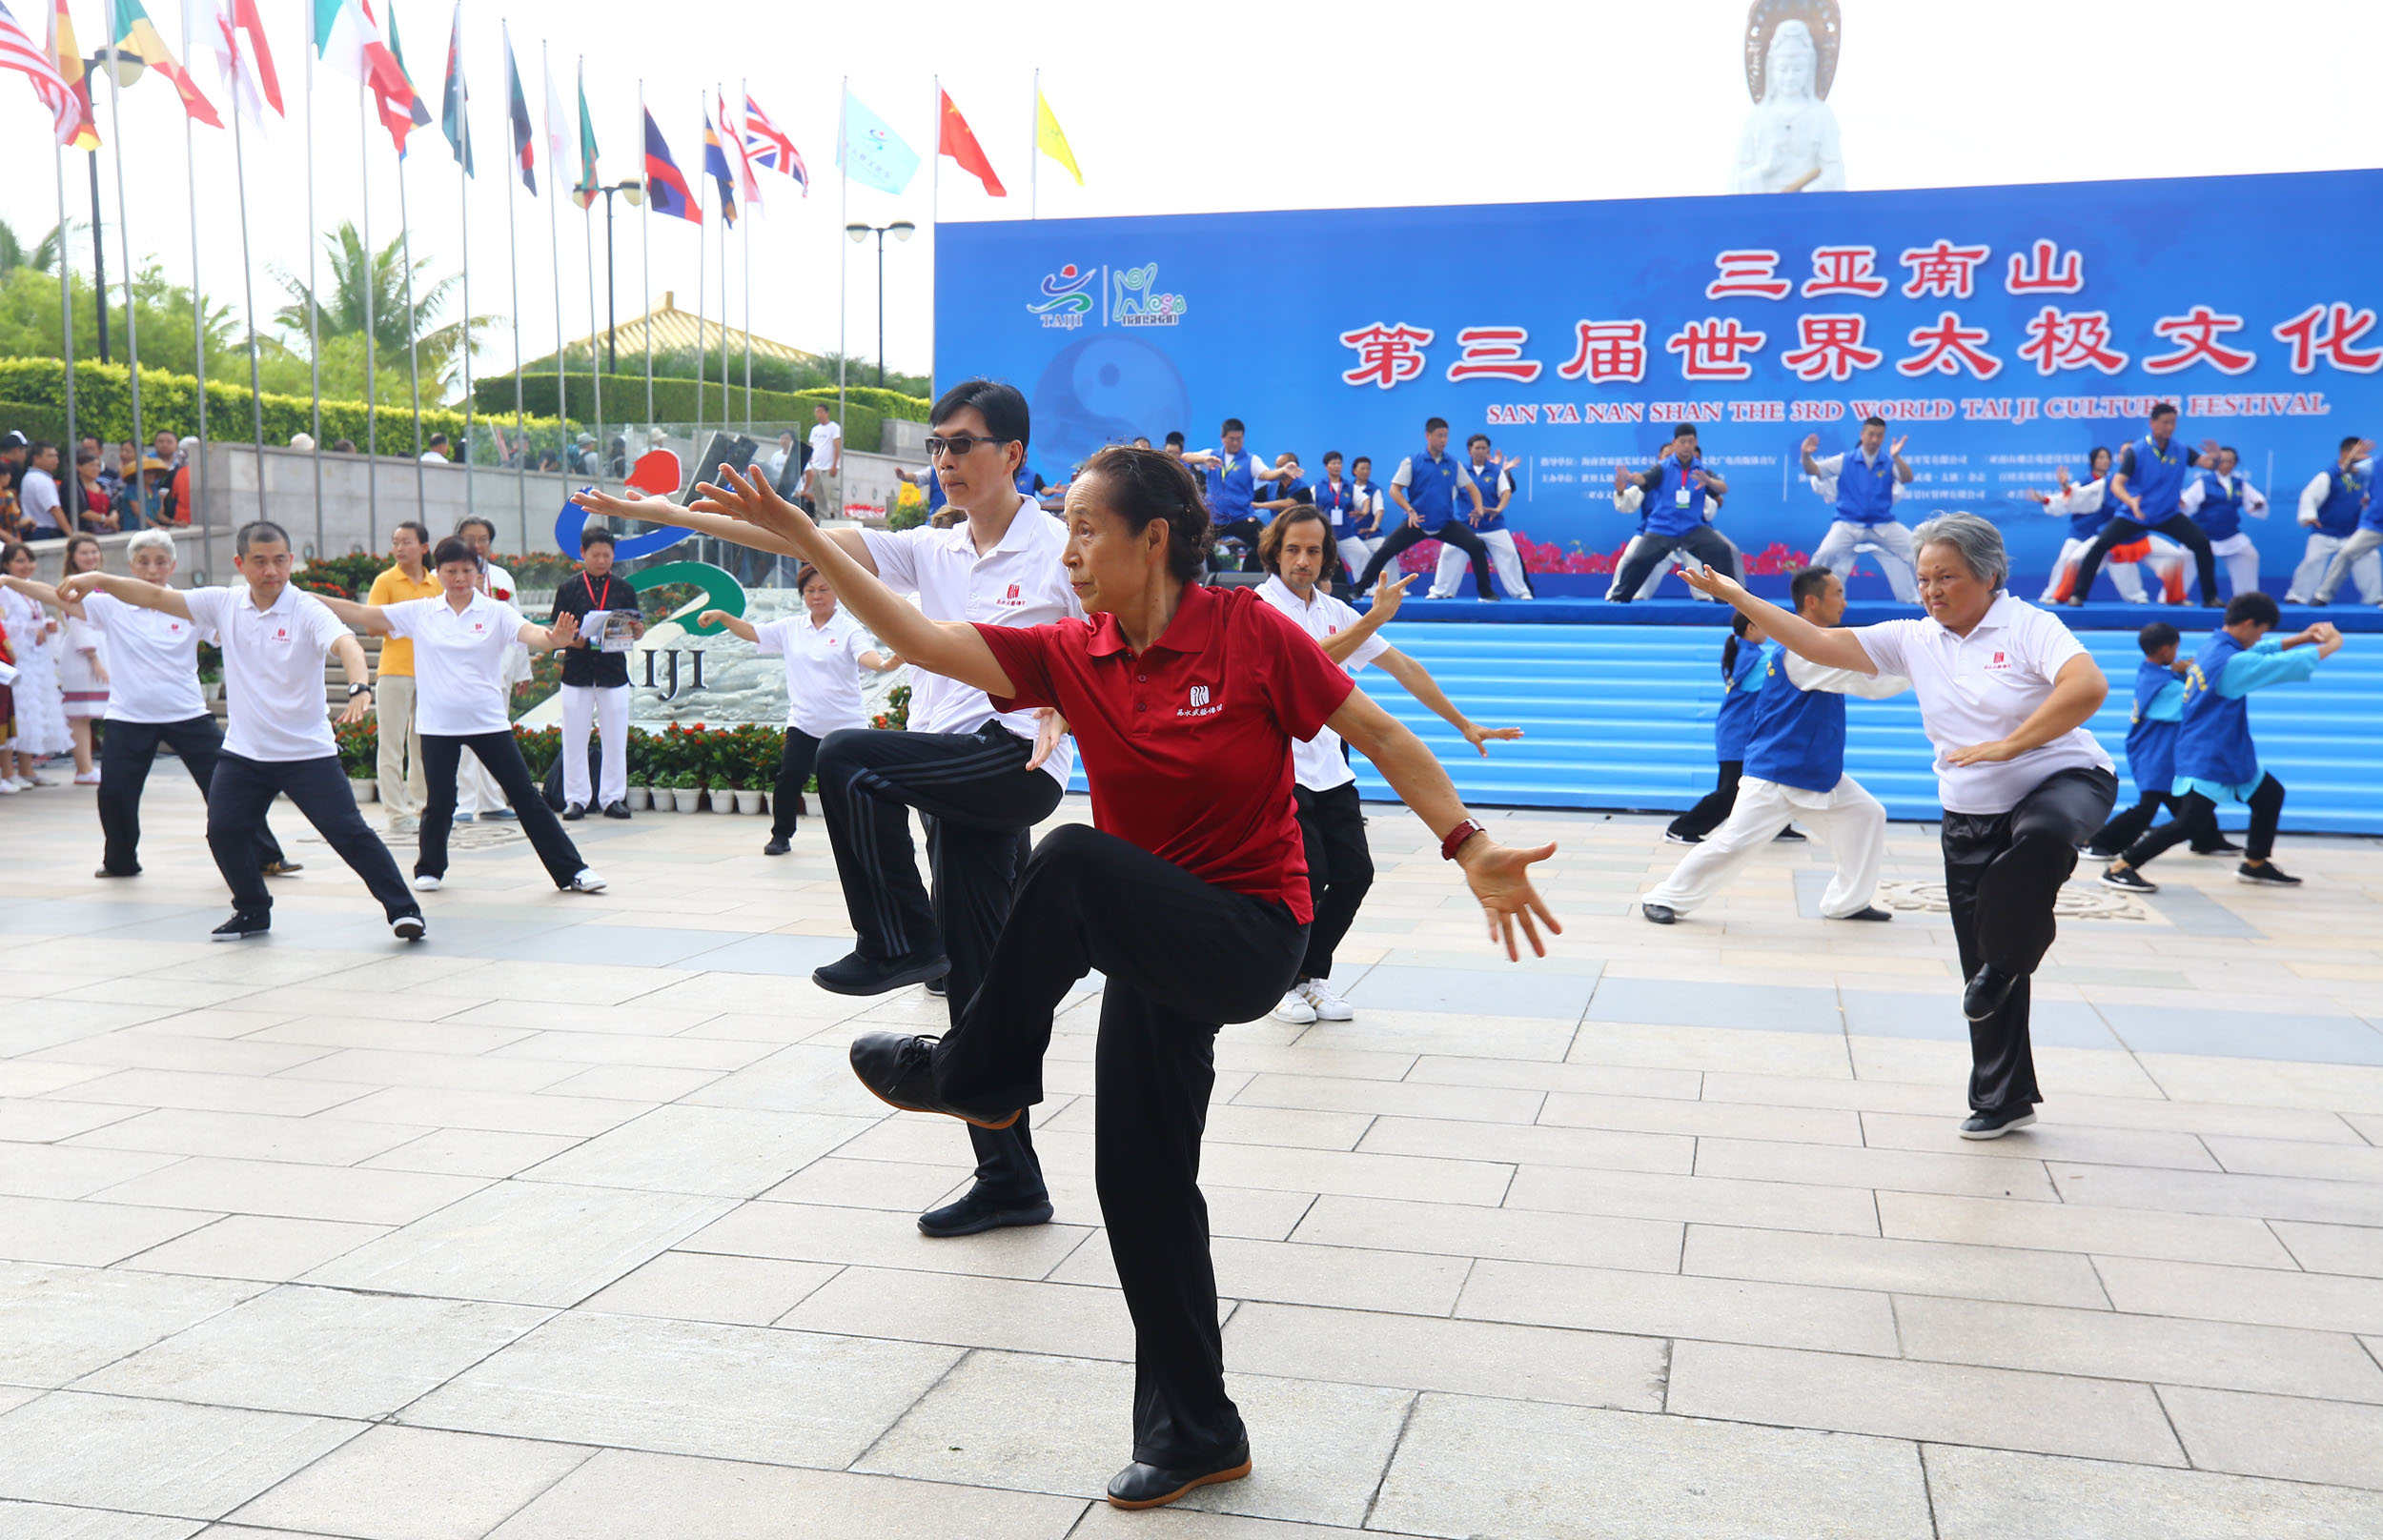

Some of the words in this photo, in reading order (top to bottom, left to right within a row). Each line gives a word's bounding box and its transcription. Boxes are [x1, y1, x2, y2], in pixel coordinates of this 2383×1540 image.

[1706, 239, 2084, 300] 三亚南山
[1040, 314, 1083, 330] TAIJI
[1339, 301, 2383, 390] 第三届世界太极文化
[1487, 404, 1538, 423] SAN
[1543, 403, 1580, 423] YA
[1586, 402, 1644, 422] NAN
[1650, 401, 1723, 422] SHAN
[1728, 401, 1784, 421] THE
[1790, 400, 1844, 420] 3RD
[1850, 398, 1954, 420] WORLD
[1962, 397, 2009, 419] TAI
[2011, 396, 2040, 424] JI
[2187, 393, 2331, 416] FESTIVAL
